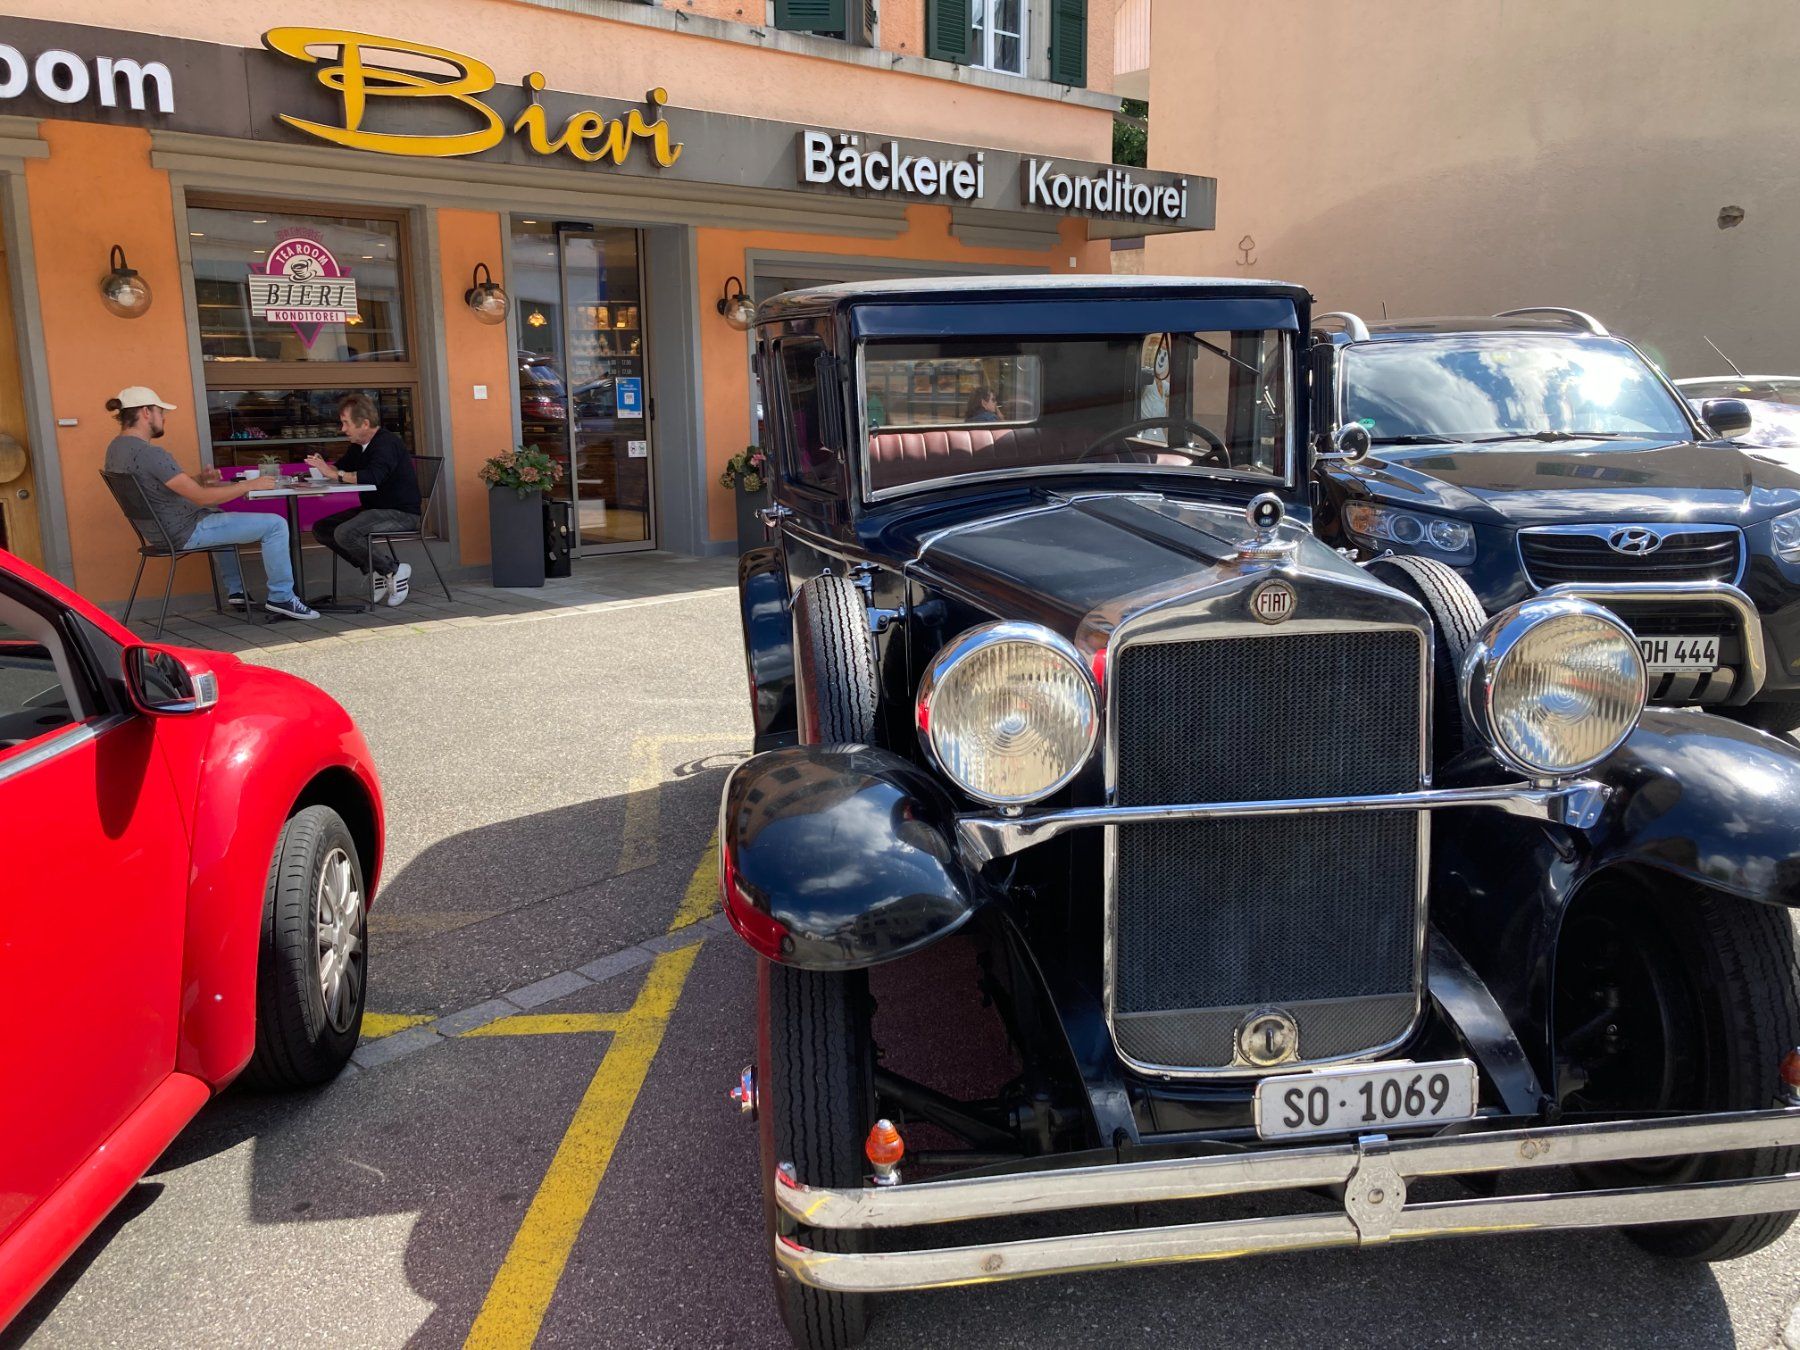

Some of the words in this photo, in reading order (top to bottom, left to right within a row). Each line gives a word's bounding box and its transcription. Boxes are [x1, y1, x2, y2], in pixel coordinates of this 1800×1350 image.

[262, 26, 684, 168] Bieri
[803, 129, 985, 199] Bäckerei
[1028, 158, 1188, 218] Konditorei
[265, 283, 346, 307] BIERI
[275, 311, 339, 321] KONDITOREI
[1260, 592, 1287, 612] FIAT
[1674, 640, 1716, 663] 444
